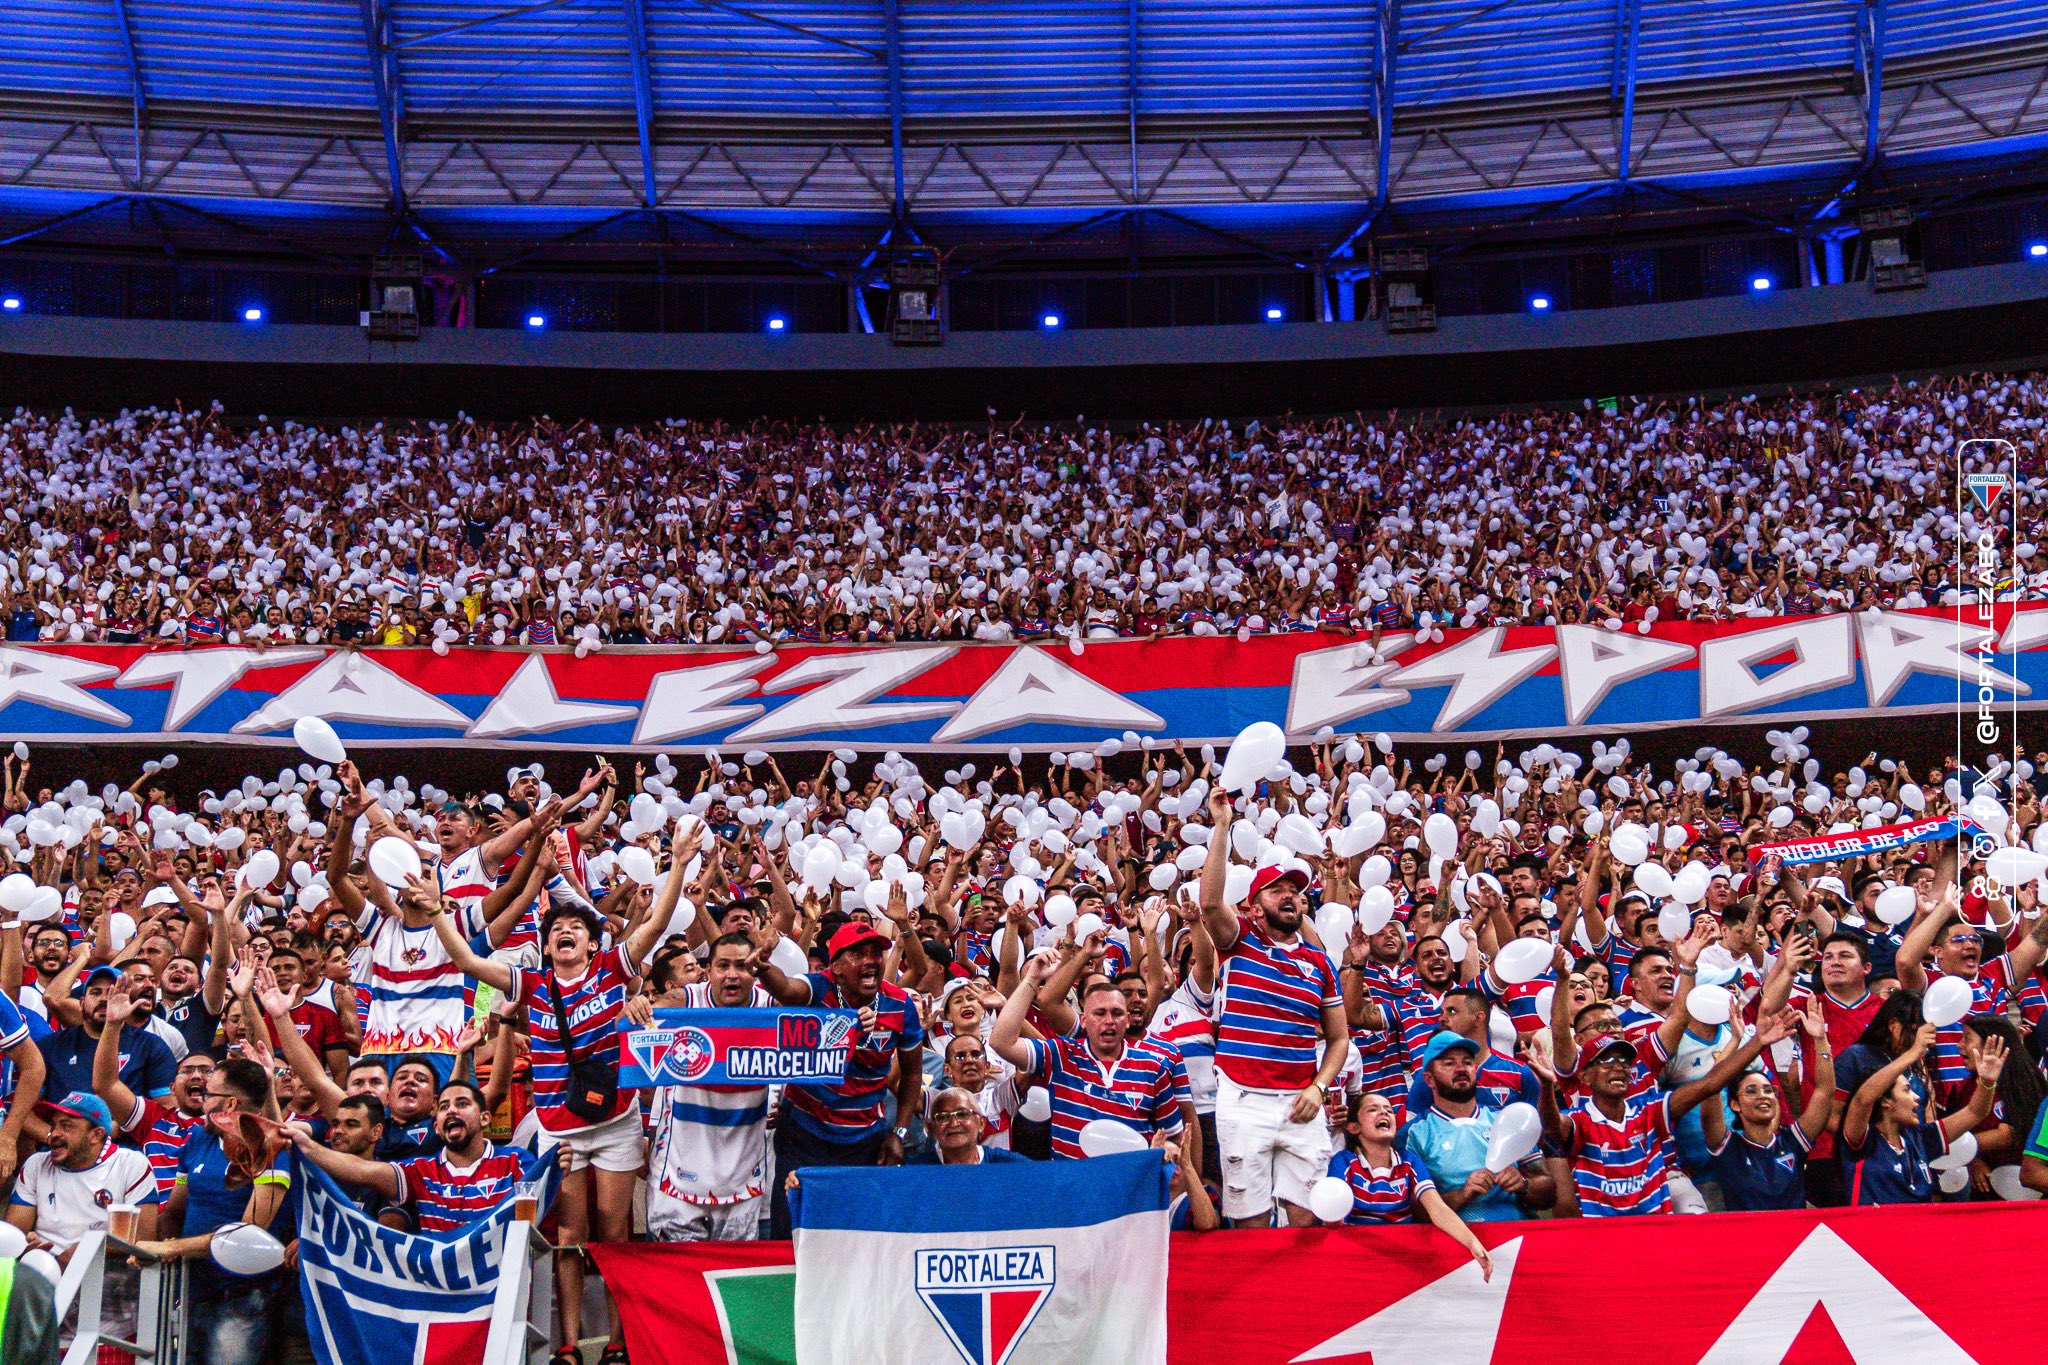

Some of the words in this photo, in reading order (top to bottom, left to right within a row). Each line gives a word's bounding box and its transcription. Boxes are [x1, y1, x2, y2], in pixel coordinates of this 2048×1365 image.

[1867, 832, 1899, 850] DE
[632, 1033, 673, 1045] FORTALEZA
[782, 1018, 818, 1047] MC
[927, 1251, 1045, 1283] FORTALEZA
